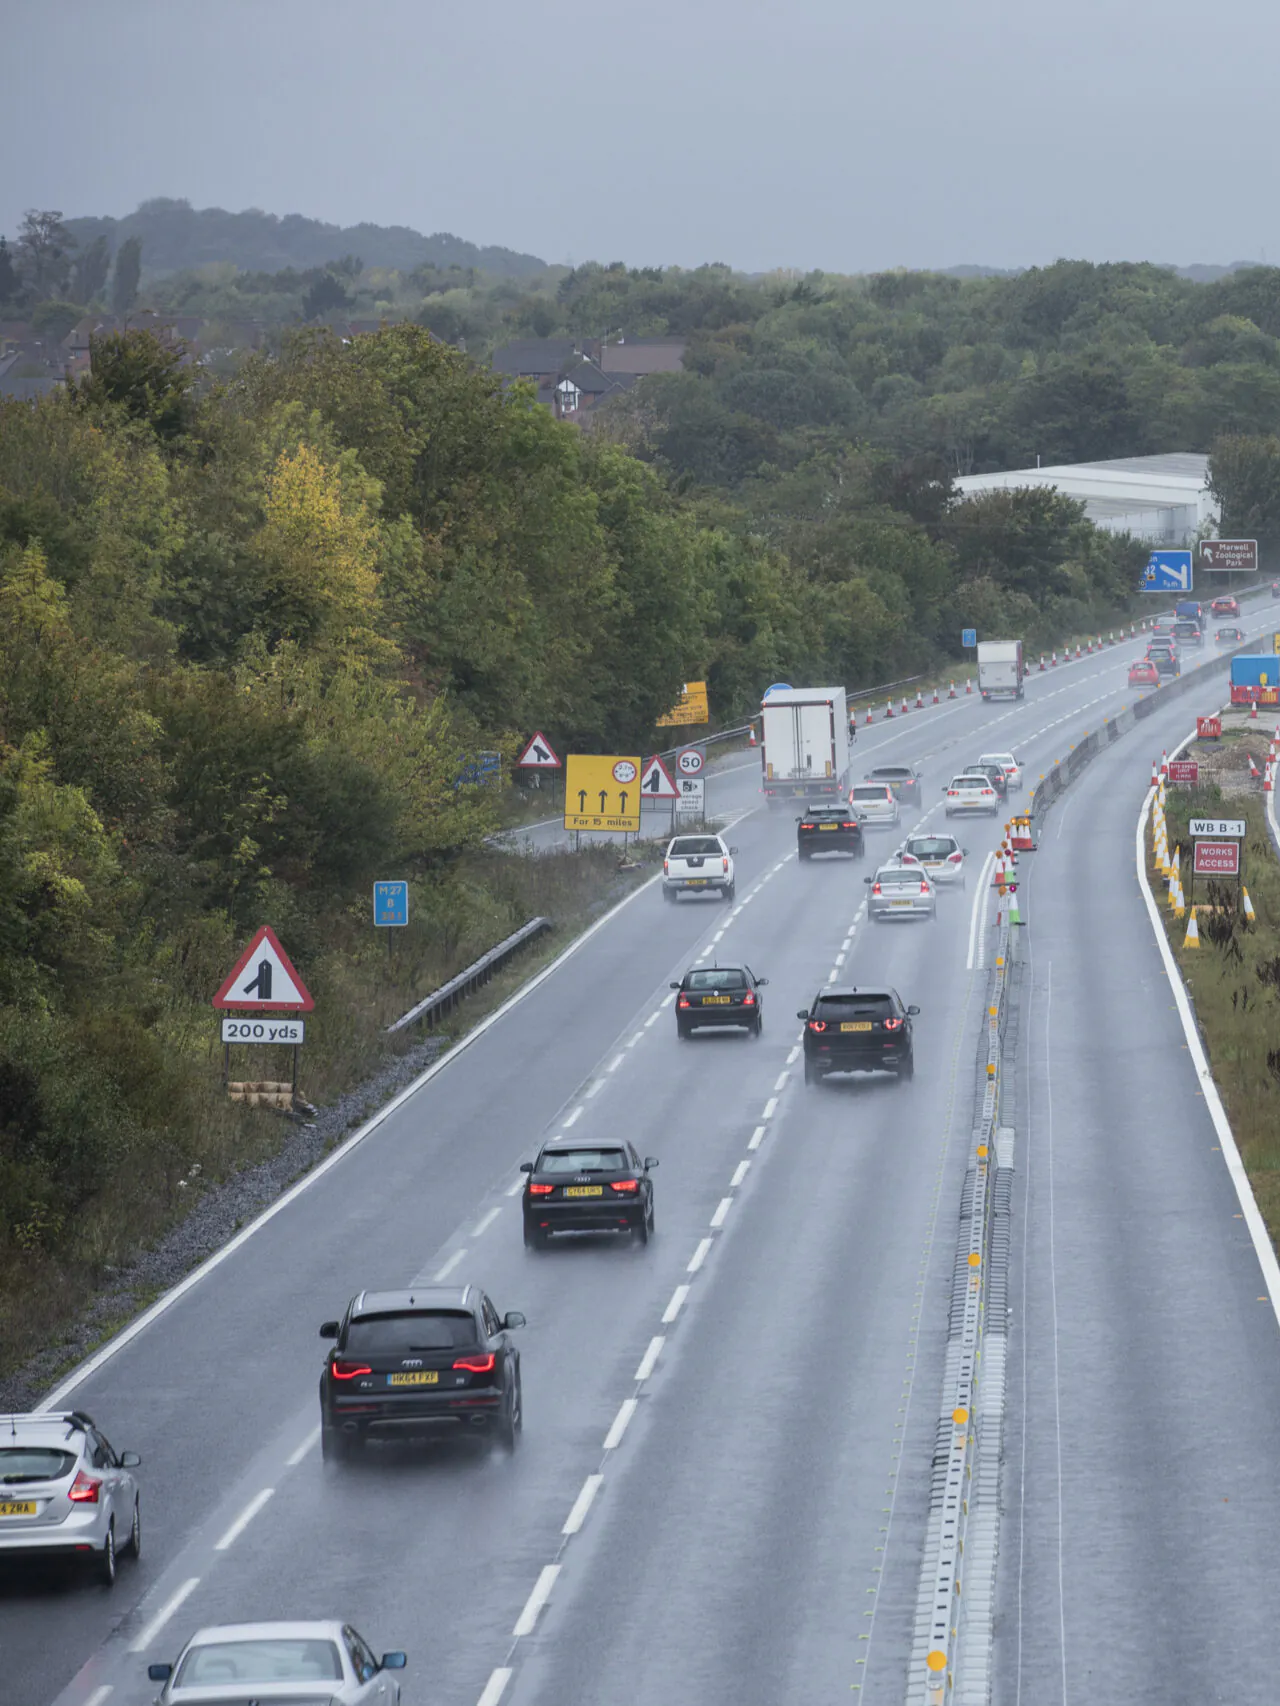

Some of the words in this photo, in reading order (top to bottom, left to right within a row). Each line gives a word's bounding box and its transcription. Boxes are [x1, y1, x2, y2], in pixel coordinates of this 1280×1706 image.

[1219, 543, 1249, 551] Marwell
[1215, 551, 1253, 560] Zoological
[1225, 559, 1242, 567] Park
[682, 757, 700, 768] 50
[573, 816, 588, 825] For
[607, 817, 633, 827] miles
[1194, 823, 1214, 832] WB
[1200, 848, 1233, 856] WORKS
[1199, 859, 1234, 868] ACCESS
[387, 898, 395, 908] B
[227, 1024, 264, 1038] 200
[269, 1025, 298, 1041] yds
